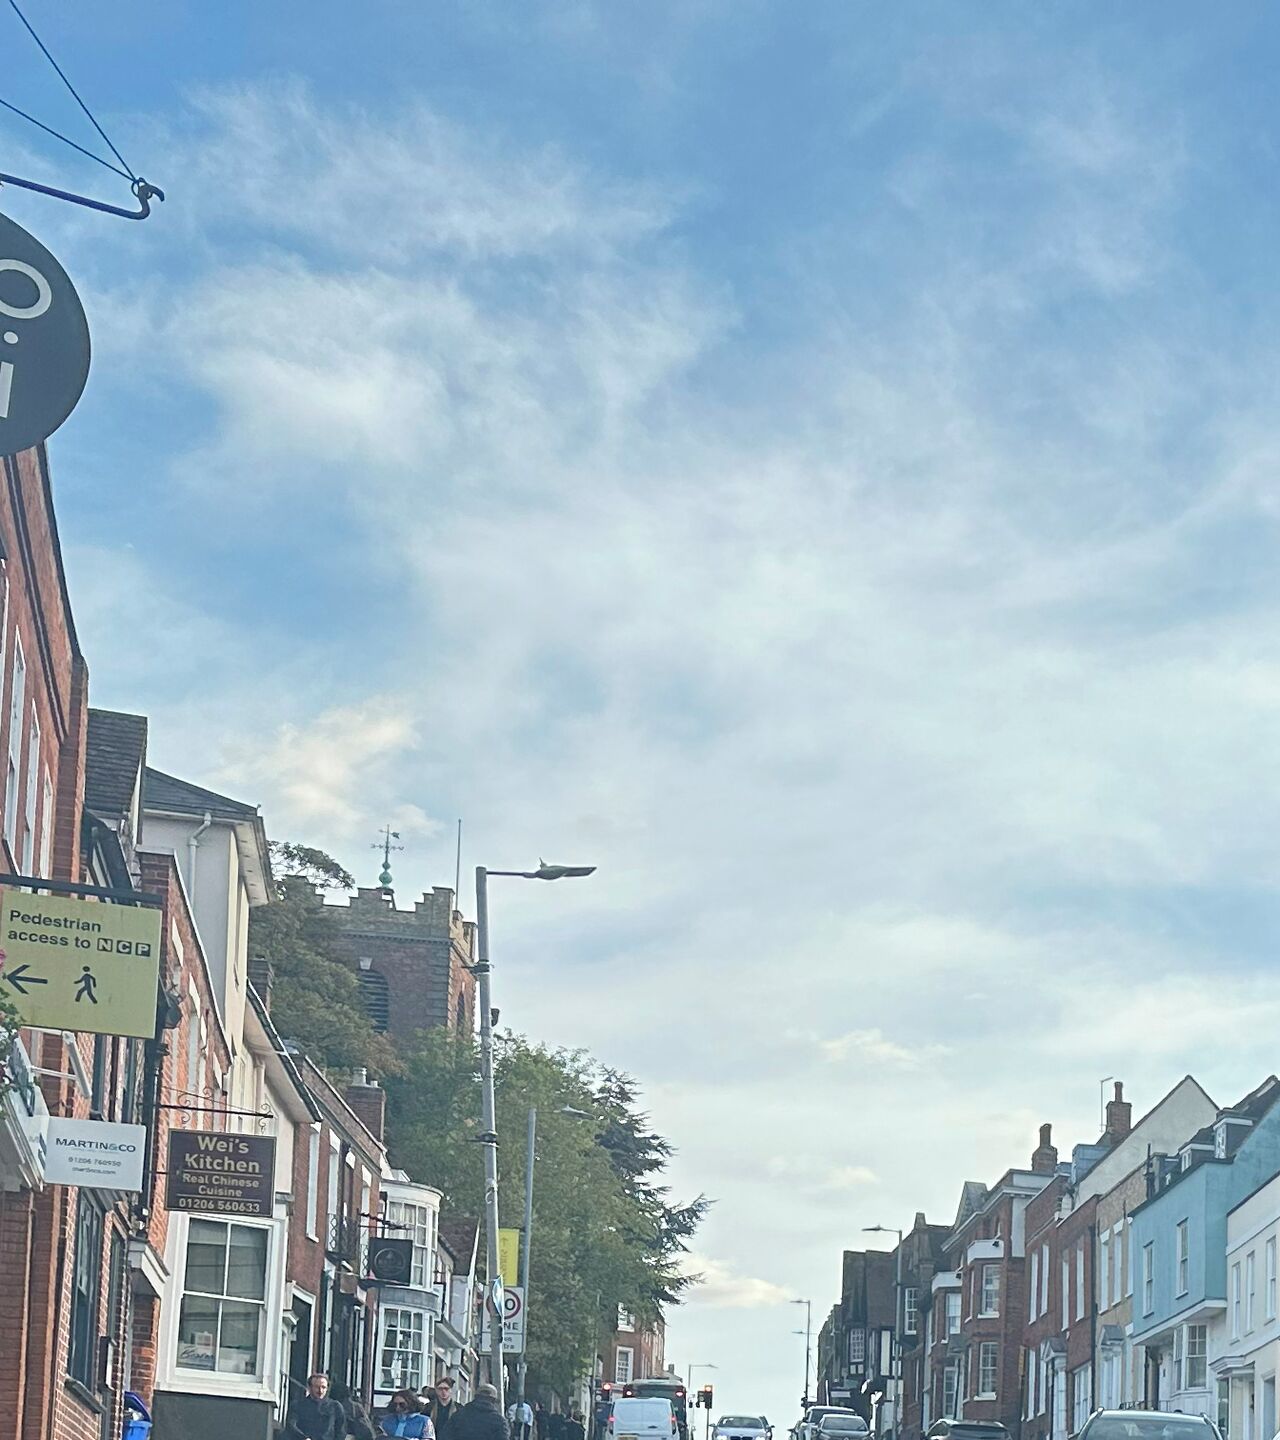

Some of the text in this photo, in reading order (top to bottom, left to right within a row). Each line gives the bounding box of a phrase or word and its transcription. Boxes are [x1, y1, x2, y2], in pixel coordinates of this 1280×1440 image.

[10, 909, 102, 933] Pedestrian
[8, 930, 151, 957] access to NCP
[55, 1138, 136, 1153] MARTIN&CO
[197, 1135, 249, 1154] Wei's
[185, 1153, 260, 1173] Kitchen
[182, 1173, 259, 1188] Real Chinese
[198, 1185, 243, 1197] Cuisine
[179, 1198, 260, 1213] 01206 560633
